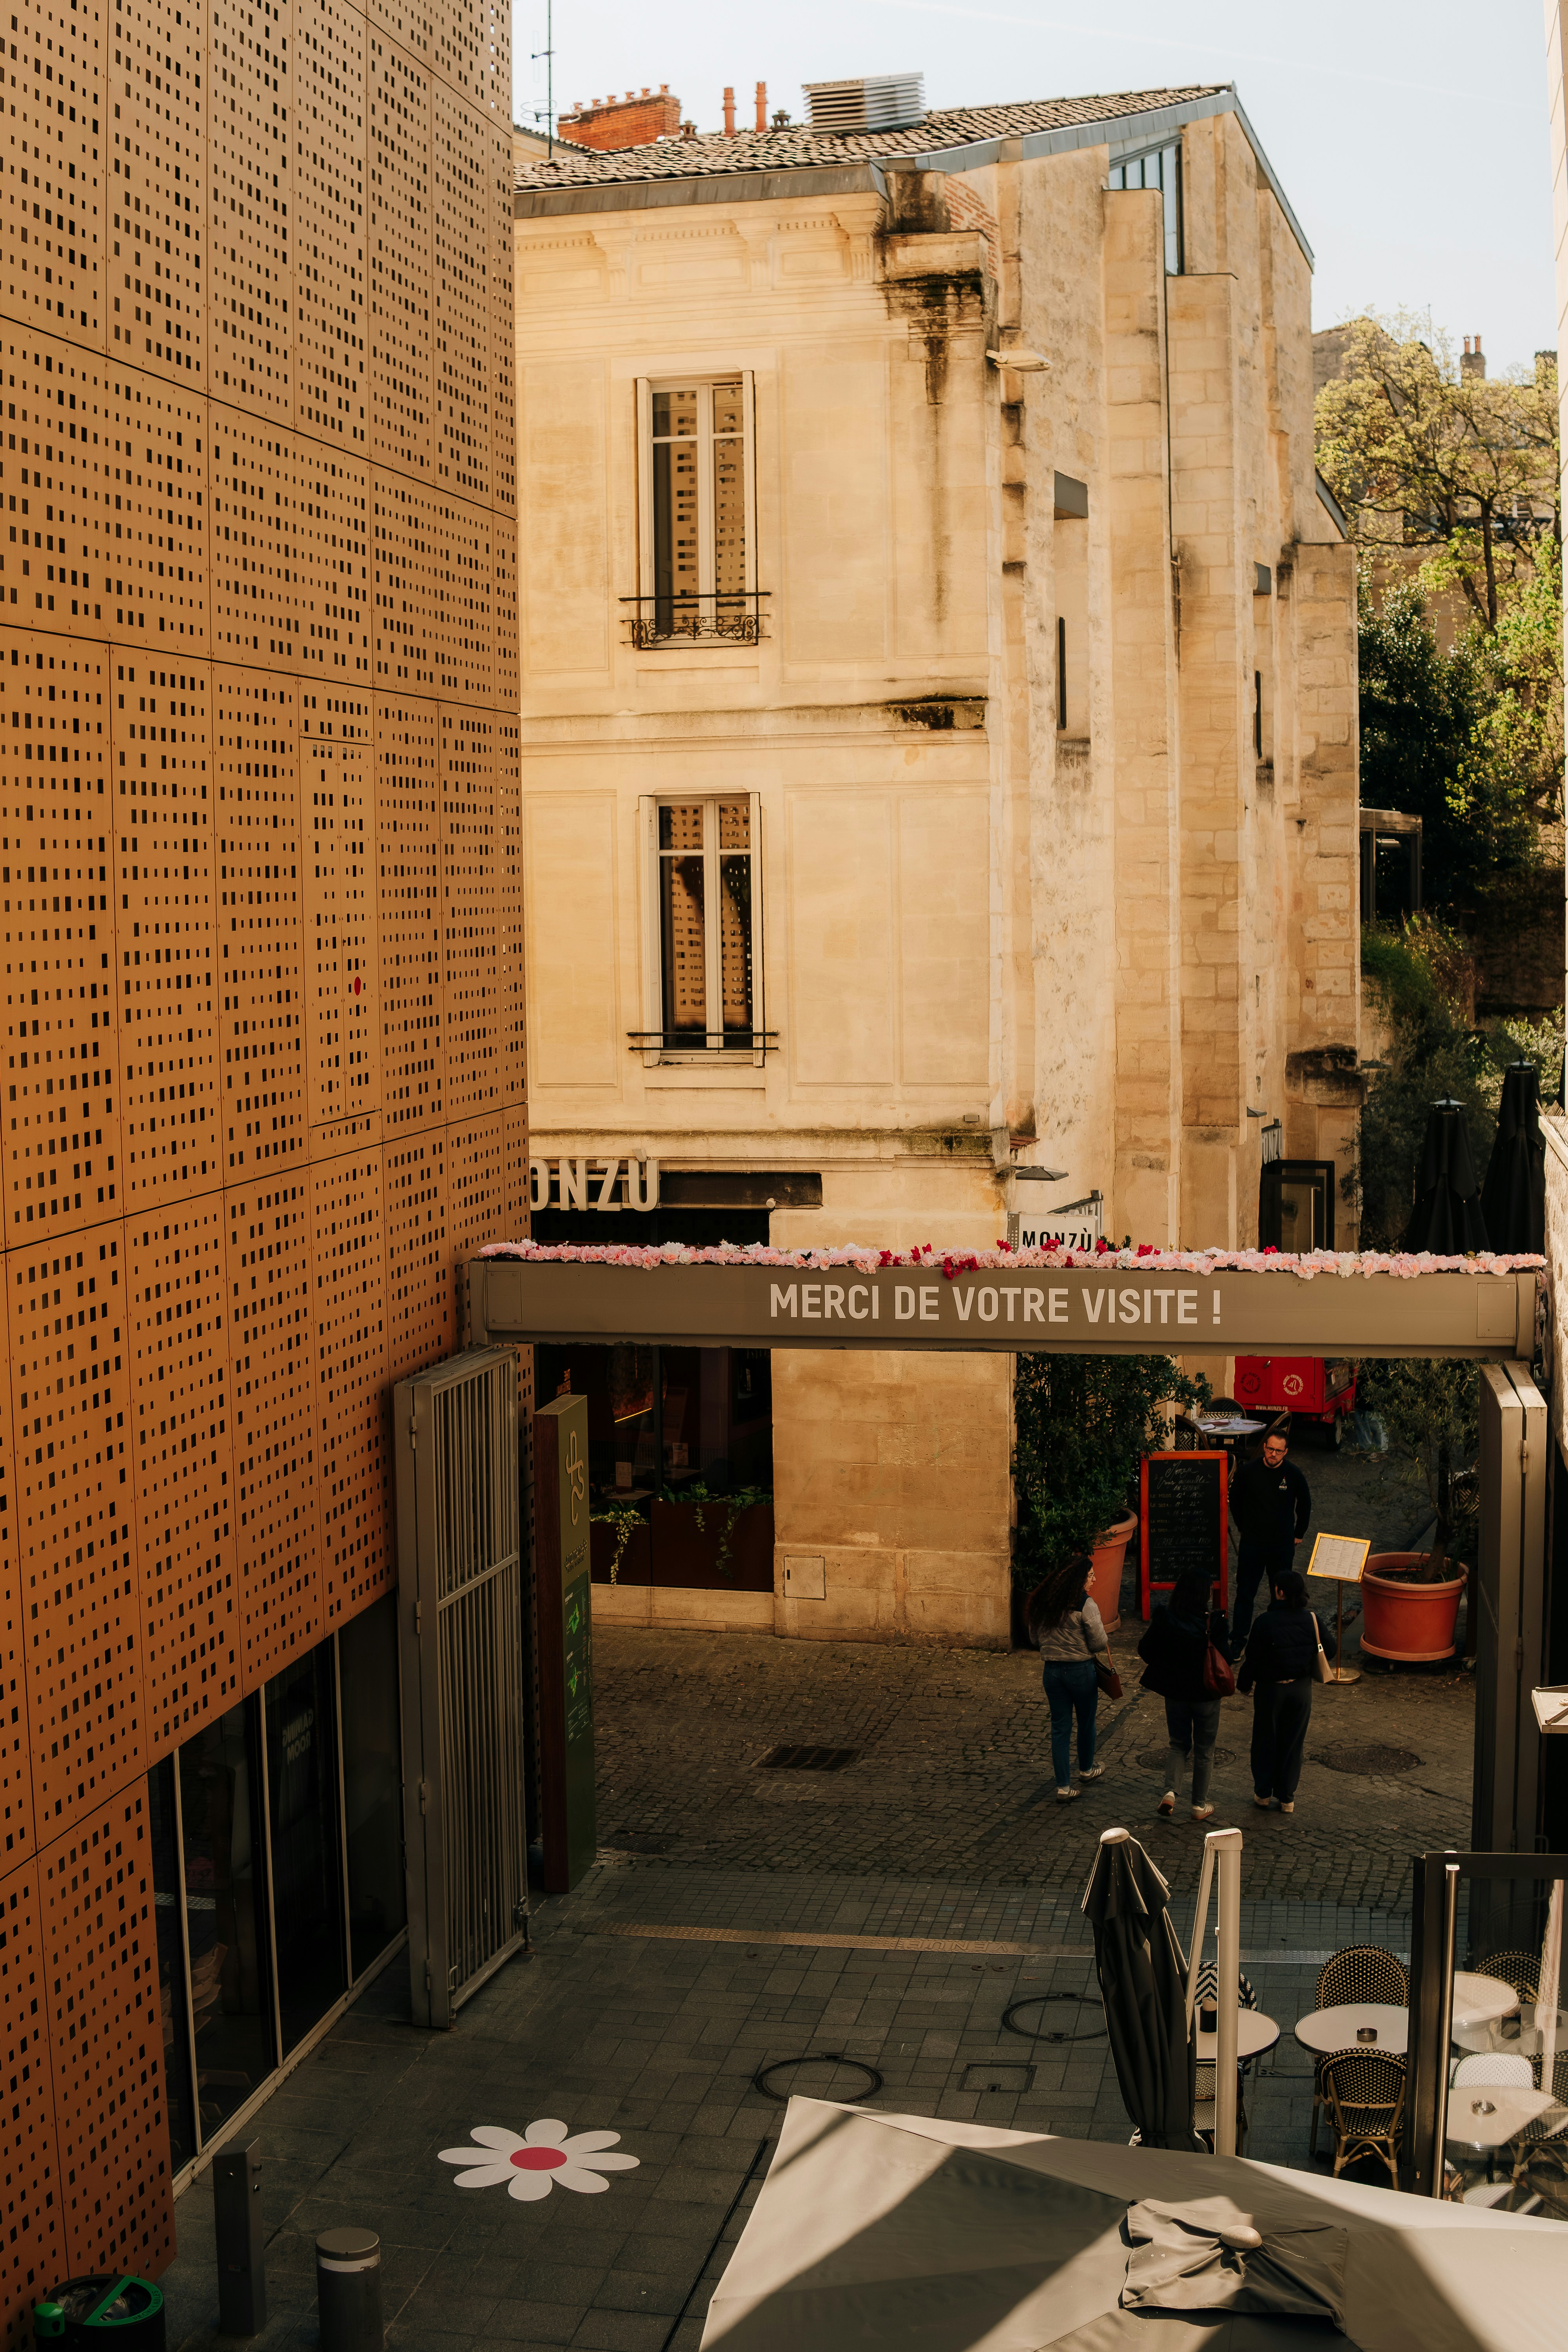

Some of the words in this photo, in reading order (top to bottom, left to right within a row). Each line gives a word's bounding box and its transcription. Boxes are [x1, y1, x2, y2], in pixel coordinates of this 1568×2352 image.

[1022, 1227, 1092, 1252] MONZÙ
[771, 1284, 878, 1319] MERCI
[895, 1286, 939, 1320] DE
[953, 1287, 1068, 1322] VOTRE
[1082, 1289, 1197, 1323] VISITE
[1213, 1290, 1220, 1324] !
[132, 2290, 160, 2320] RECYCLABLES
